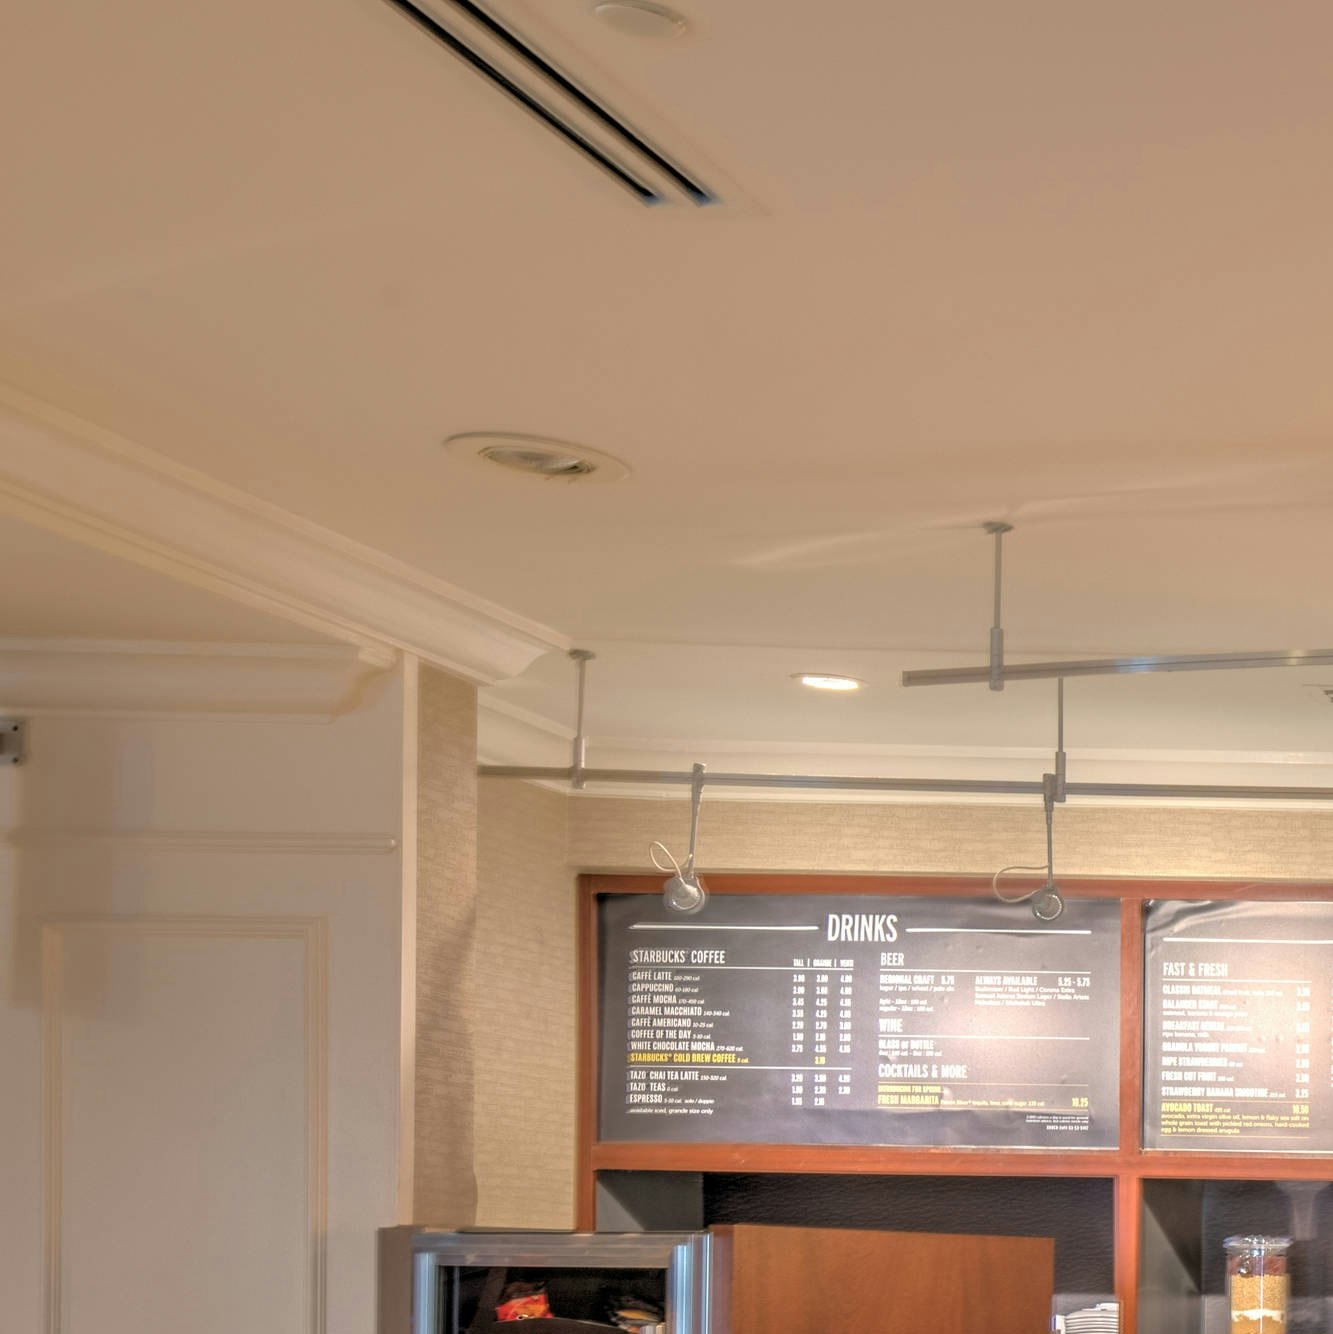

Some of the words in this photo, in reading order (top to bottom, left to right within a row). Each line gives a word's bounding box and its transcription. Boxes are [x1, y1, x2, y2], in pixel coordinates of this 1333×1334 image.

[828, 914, 898, 942] DRINKS
[633, 951, 685, 962] STARBUCKS
[691, 951, 725, 963] COFFEE
[881, 953, 904, 965] BEER
[1163, 962, 1185, 976] FAST
[1189, 963, 1195, 976] &
[1199, 963, 1228, 976] FRESH
[654, 972, 672, 981] LATTE
[632, 984, 674, 992] CAPPUCCINO
[653, 995, 677, 1004] MOCHA
[632, 1007, 662, 1015] CARAMEL
[664, 1007, 702, 1016] MACCHIATO
[653, 1018, 691, 1027] AMERICANO
[631, 1030, 654, 1039] COFFEE
[656, 1030, 664, 1039] OF
[666, 1030, 677, 1039] THE
[679, 1031, 691, 1039] DAY
[631, 1042, 651, 1050] WHITE
[653, 1042, 689, 1051] CHOCOLATE
[691, 1042, 715, 1051] MOCHA
[674, 1054, 690, 1062] COLD
[692, 1054, 711, 1062] BREW
[712, 1054, 736, 1063] COFFEE
[650, 1071, 666, 1080] CHAI
[668, 1071, 679, 1080] TEA
[681, 1072, 699, 1080] LATTE
[879, 1064, 928, 1078] COCKTAILS
[932, 1064, 937, 1078] &
[941, 1065, 968, 1078] MORE
[650, 1083, 666, 1091] TEAS
[630, 1094, 662, 1103] ESPRESSO
[1161, 1103, 1192, 1112] AVOCADO
[1194, 1103, 1213, 1113] TOAST
